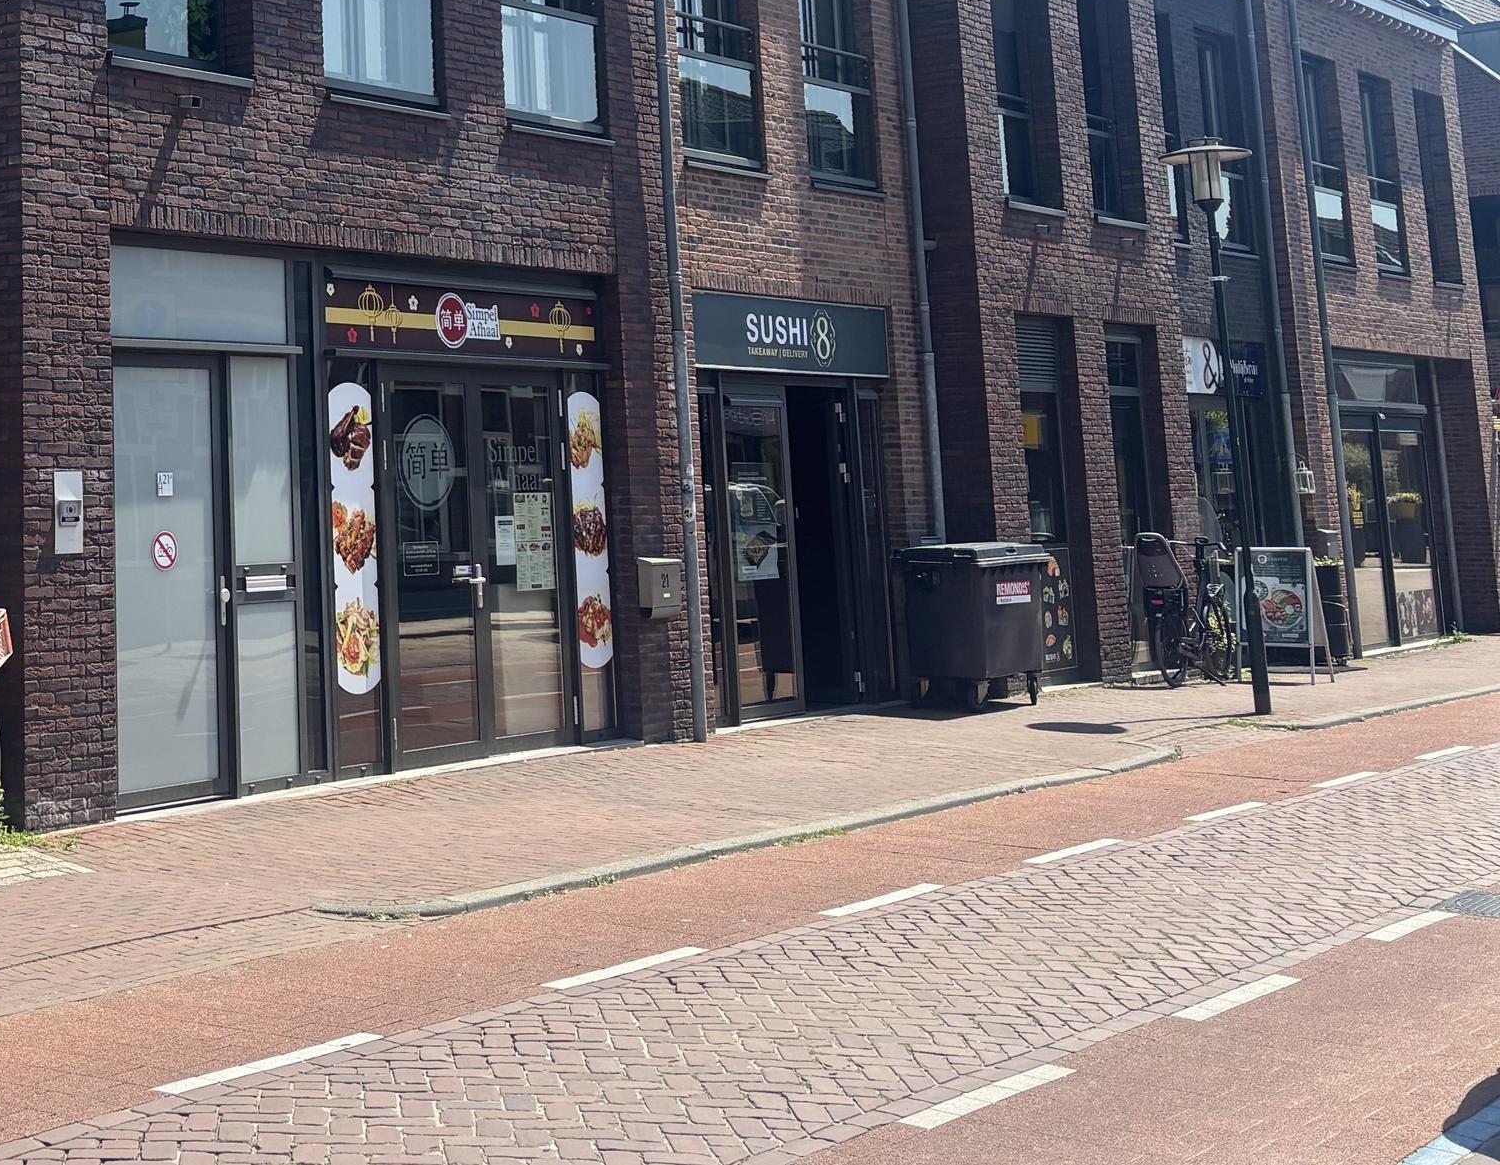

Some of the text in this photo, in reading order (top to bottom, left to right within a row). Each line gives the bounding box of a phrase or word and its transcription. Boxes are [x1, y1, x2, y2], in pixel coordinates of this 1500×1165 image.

[440, 309, 465, 331] 简单
[466, 304, 497, 324] Simpel
[470, 322, 499, 338] Afhaal
[746, 313, 831, 360] SUSHI 8
[747, 346, 809, 359] TAKEAWAY DELIVERY
[405, 442, 450, 480] 简单
[488, 437, 540, 468] Simpel
